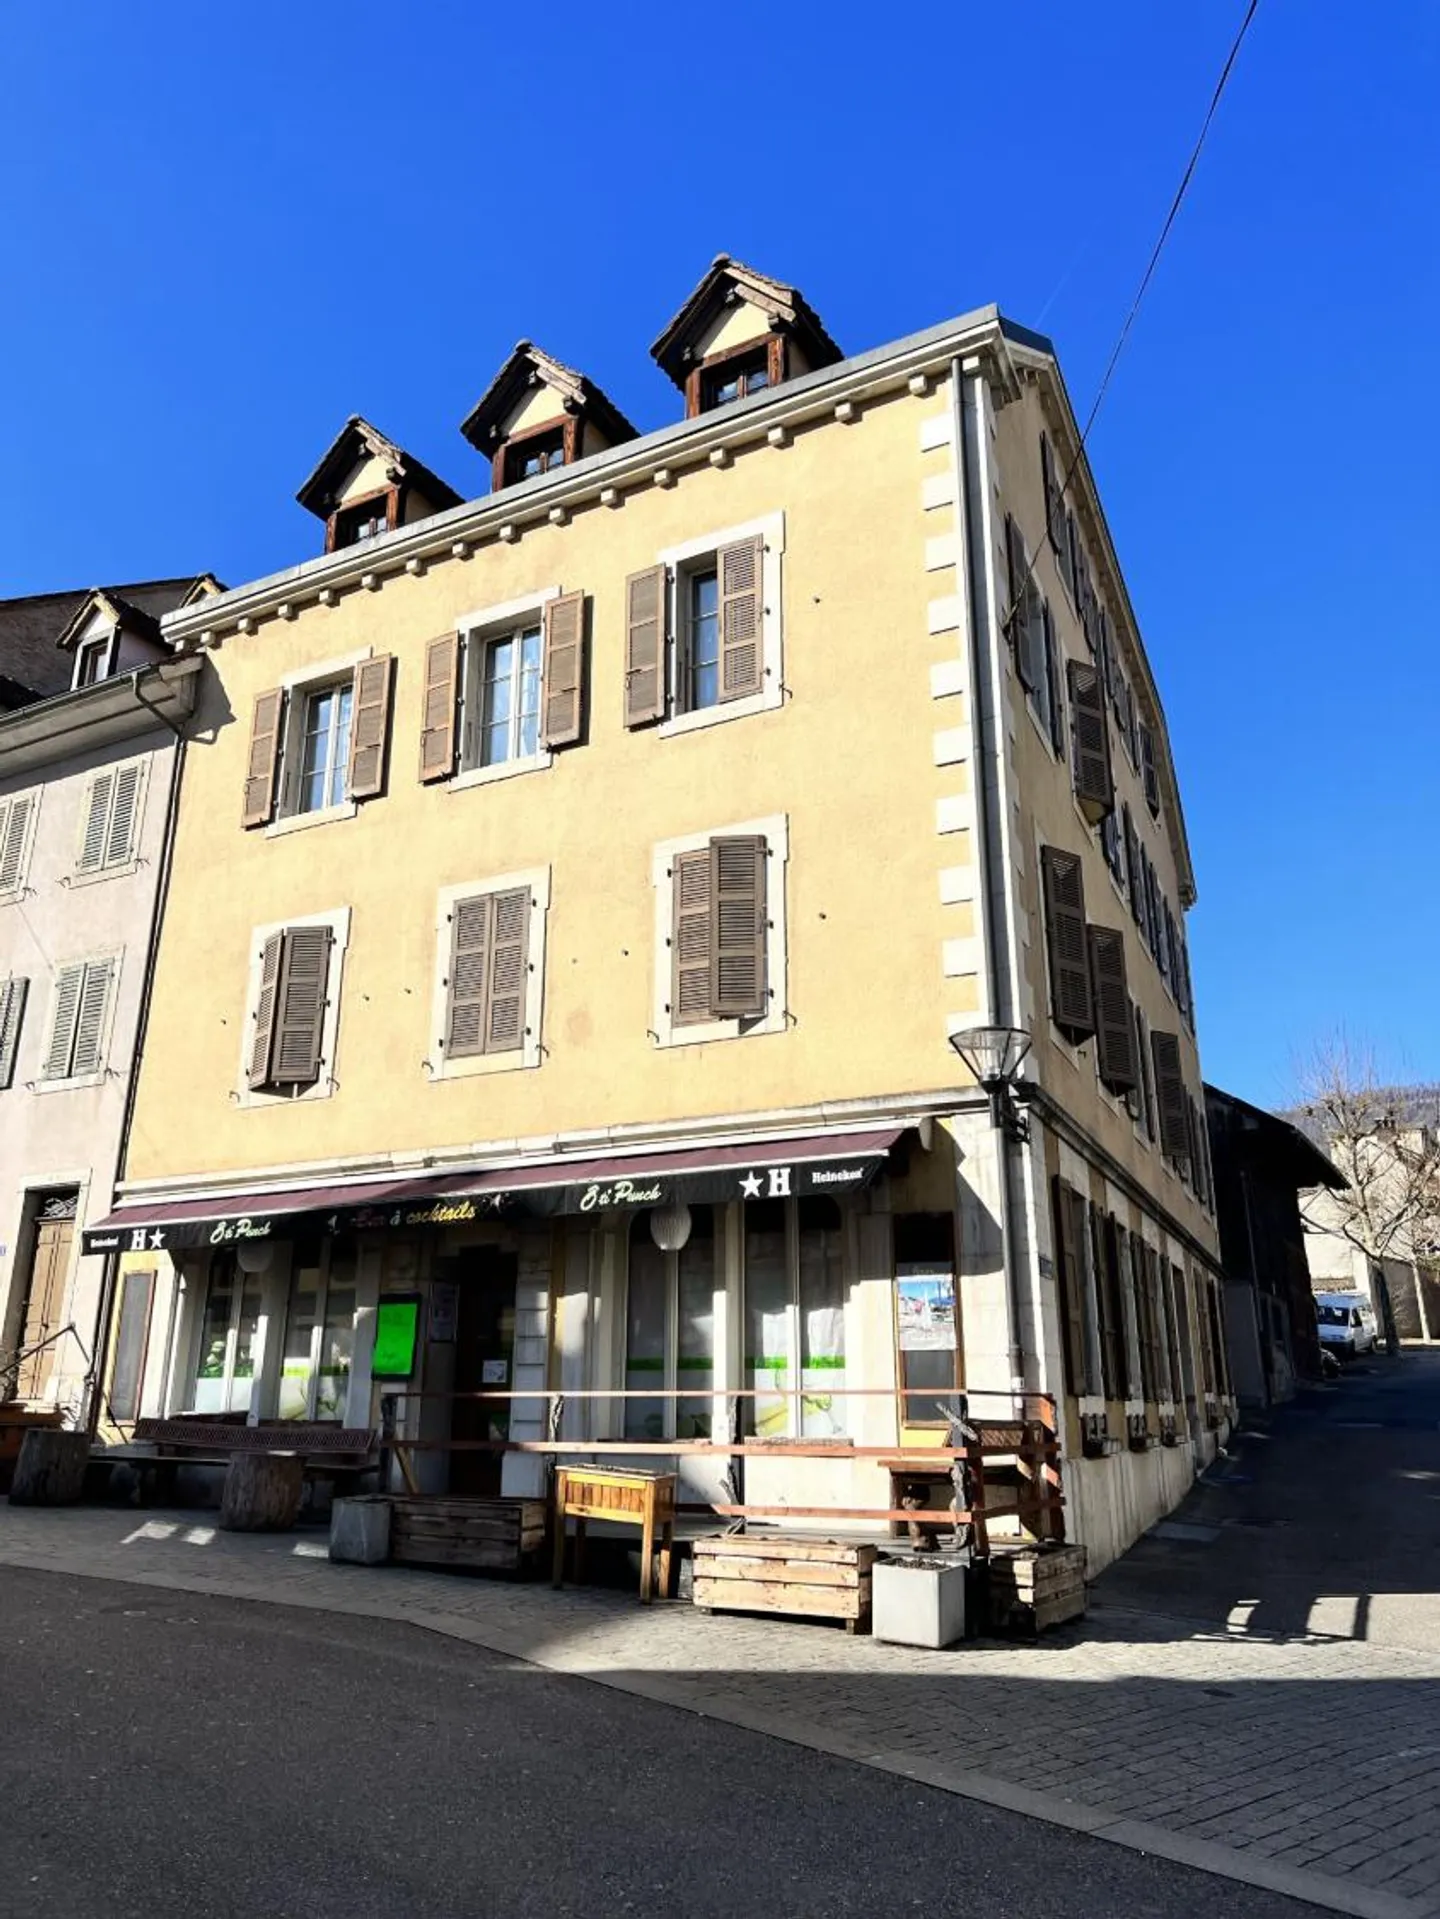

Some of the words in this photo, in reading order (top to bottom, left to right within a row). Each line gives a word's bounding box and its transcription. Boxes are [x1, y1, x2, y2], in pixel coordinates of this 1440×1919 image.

[613, 1179, 661, 1204] Punch
[768, 1167, 791, 1197] H
[131, 1227, 147, 1250] H
